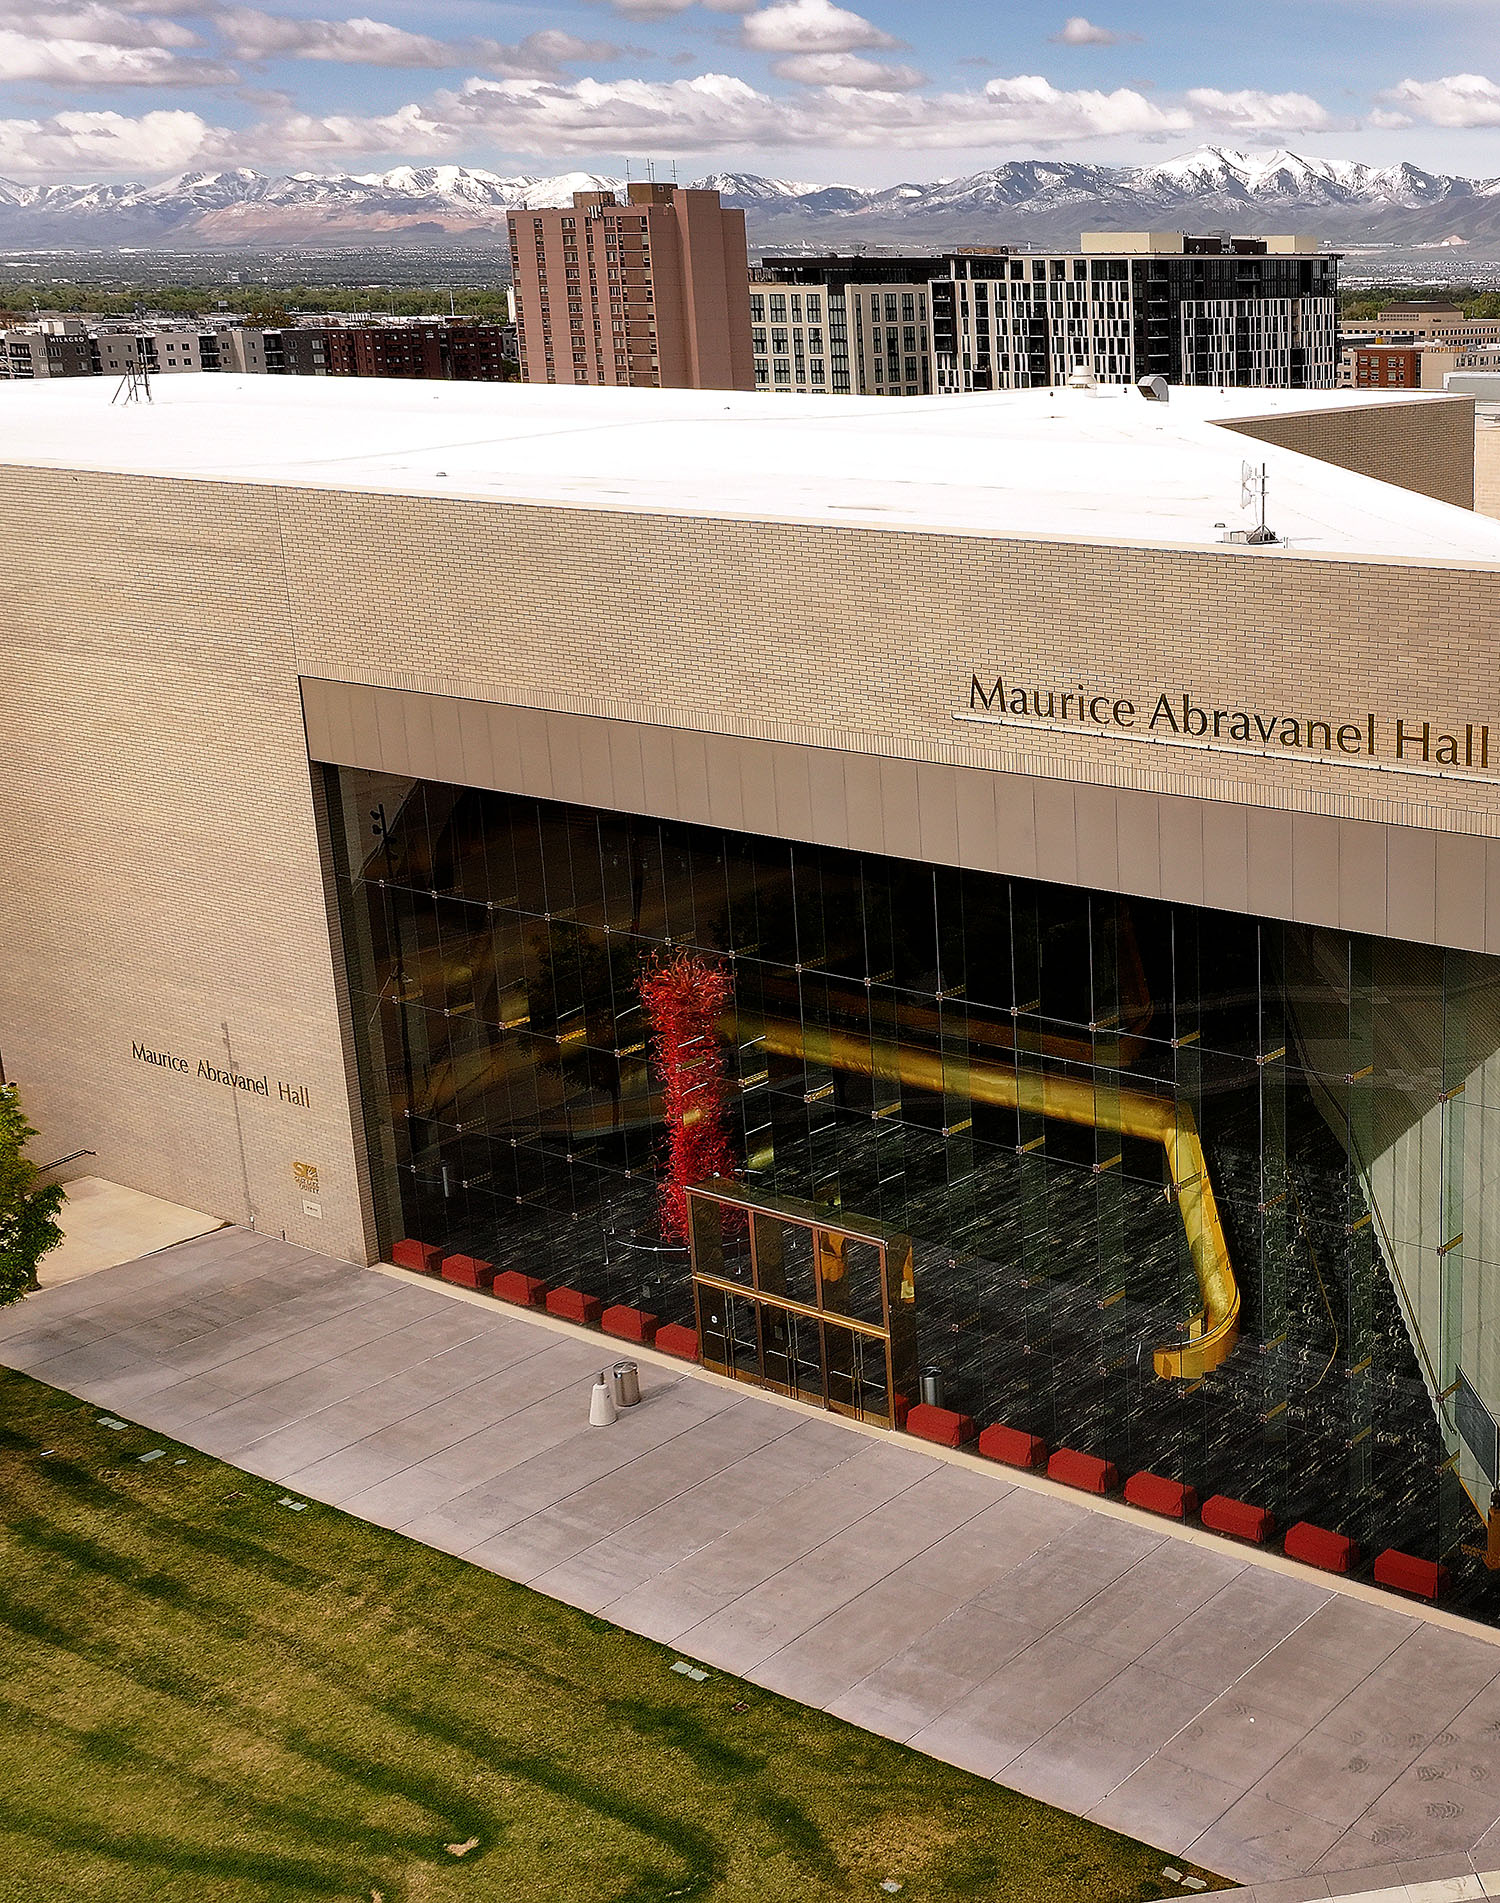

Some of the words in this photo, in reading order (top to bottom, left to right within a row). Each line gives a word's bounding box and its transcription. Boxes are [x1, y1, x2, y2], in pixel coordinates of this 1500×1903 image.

[969, 672, 1136, 729] Maurice
[1147, 692, 1376, 757] Abravanel
[1395, 718, 1490, 769] Hall
[131, 1040, 190, 1074] Maurice
[197, 1059, 270, 1097] Abravanel
[277, 1081, 311, 1109] Hall
